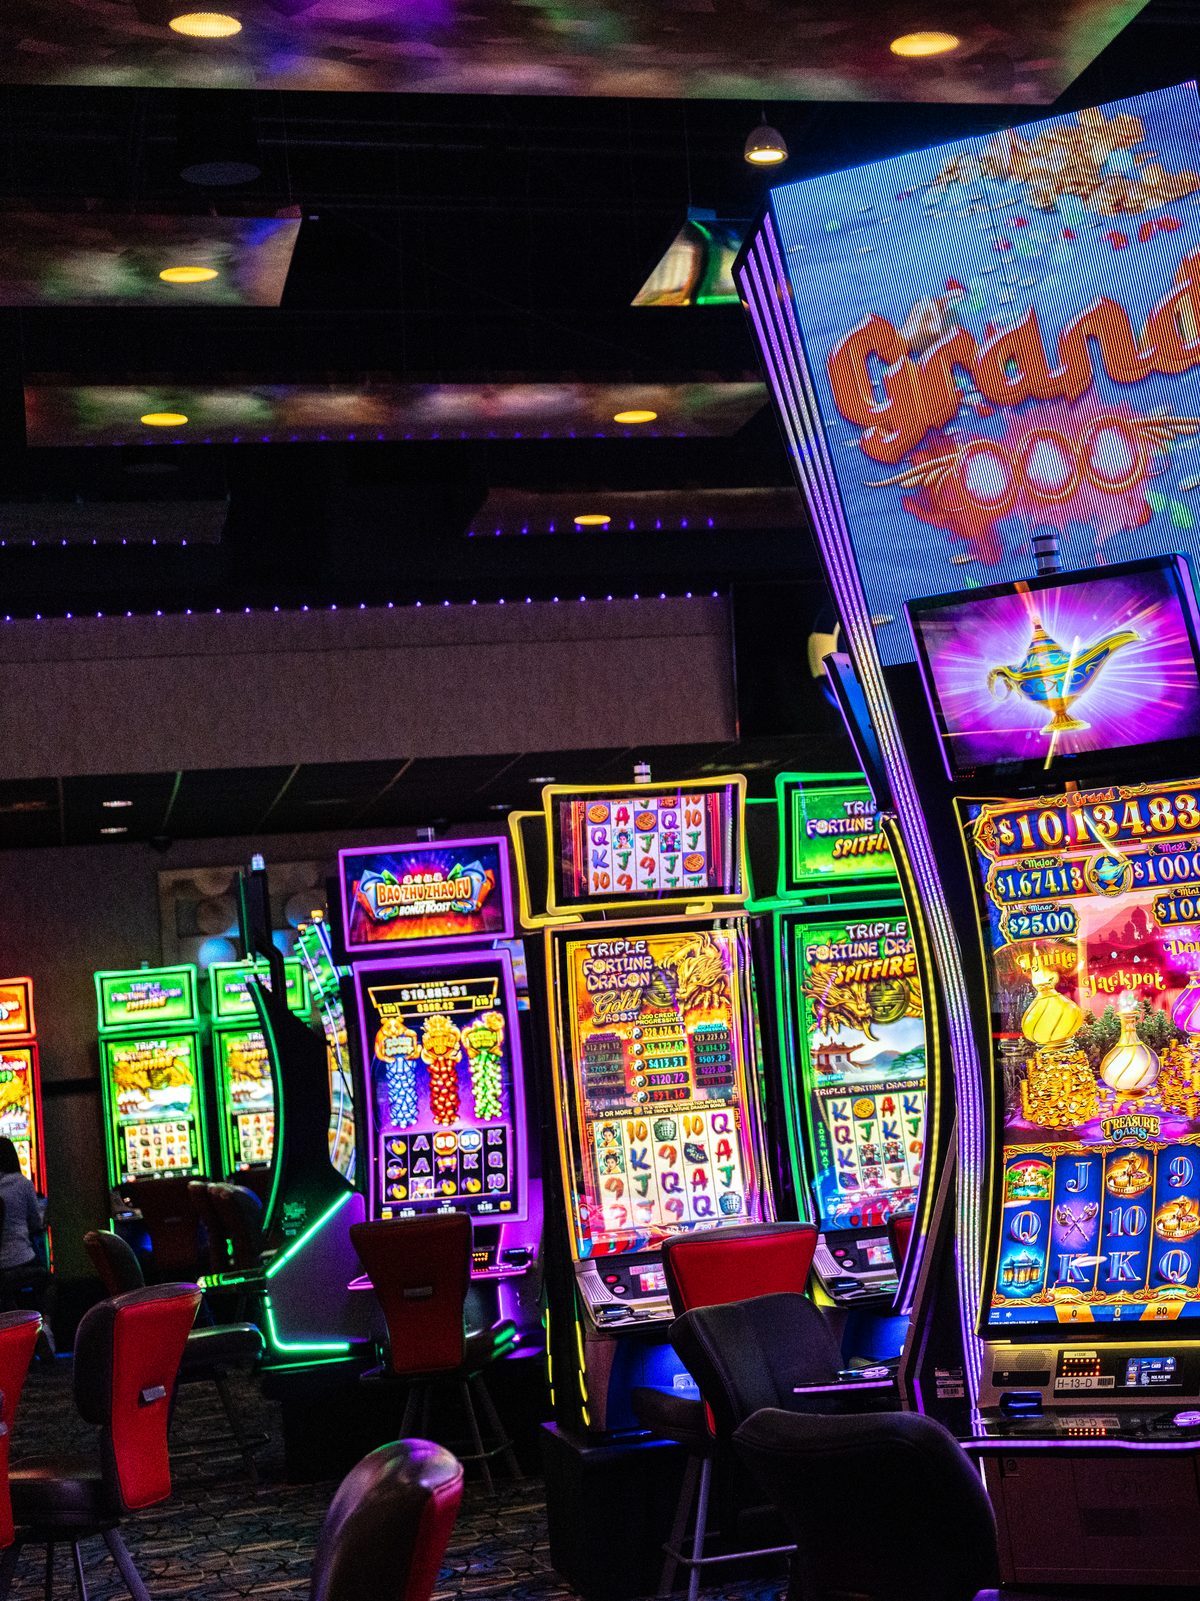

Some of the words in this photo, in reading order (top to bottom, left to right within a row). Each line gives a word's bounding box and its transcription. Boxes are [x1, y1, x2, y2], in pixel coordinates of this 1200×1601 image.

[1072, 787, 1115, 806] Grand
[615, 806, 630, 827] A
[661, 810, 680, 829] Q
[684, 809, 702, 828] 10
[806, 817, 874, 836] FORTUNE
[590, 827, 610, 846] Q
[639, 834, 655, 853] J
[686, 831, 702, 850] J
[591, 849, 610, 869] K
[616, 850, 632, 871] J
[640, 856, 656, 876] 9
[663, 854, 679, 874] J
[1025, 858, 1055, 869] Major
[376, 882, 400, 906] BAO
[401, 884, 425, 902] ZHU
[425, 880, 456, 899] ZHAO
[455, 876, 472, 898] FU
[592, 871, 611, 891] 10
[616, 873, 633, 892] 9
[996, 867, 1085, 898] $1,674.13
[1177, 886, 1200, 897] Mini
[425, 901, 451, 913] BOOST
[1027, 903, 1053, 912] Minor
[846, 922, 907, 939] TRIPLE
[1009, 911, 1074, 936] $25.00
[587, 940, 646, 957] TRIPLE
[806, 941, 879, 962] FORTUNE
[582, 956, 653, 975] FORTUNE
[834, 953, 915, 985] SPITFIRE
[1016, 948, 1077, 972] Ignite
[587, 971, 651, 991] DRAGON
[1081, 969, 1167, 998] Jackpot
[591, 987, 644, 1024] Gold
[605, 1012, 639, 1024] BOOST
[635, 1017, 684, 1026] PROGRESSIVES
[648, 1056, 684, 1068] $413.51
[651, 1072, 685, 1085] $120.72
[814, 1087, 847, 1097] TRIPLE
[848, 1083, 885, 1094] FORTUNE
[886, 1079, 919, 1090] DRAGON
[615, 1108, 633, 1116] MORE
[832, 1101, 851, 1122] K
[880, 1096, 896, 1117] A
[903, 1094, 922, 1114] K
[627, 1120, 648, 1144] 10
[682, 1115, 704, 1138] 10
[711, 1113, 733, 1135] Q
[834, 1125, 854, 1145] Q
[858, 1121, 875, 1142] J
[882, 1120, 900, 1140] K
[905, 1116, 922, 1138] J
[1102, 1115, 1159, 1136] TREASURE
[1112, 1127, 1148, 1140] OASIS
[413, 1135, 430, 1151] A
[487, 1129, 502, 1145] K
[413, 1157, 431, 1173] A
[463, 1153, 479, 1169] K
[488, 1151, 504, 1168] Q
[630, 1147, 651, 1171] K
[658, 1143, 677, 1168] 9
[715, 1138, 732, 1163] A
[837, 1148, 857, 1168] K
[487, 1173, 505, 1189] 10
[604, 1177, 624, 1200] 9
[633, 1173, 652, 1198] J
[661, 1172, 684, 1194] Q
[690, 1168, 709, 1193] A
[717, 1164, 735, 1188] J
[888, 1165, 905, 1186] J
[1066, 1161, 1092, 1193] J
[1169, 1156, 1194, 1187] 9
[665, 1197, 684, 1221] 9
[693, 1195, 715, 1217] Q
[1010, 1211, 1042, 1245] Q
[1106, 1205, 1147, 1237] 10
[1056, 1253, 1091, 1284] K
[1106, 1251, 1141, 1282] K
[1158, 1249, 1192, 1285] Q
[1071, 1309, 1078, 1318] 0
[1114, 1306, 1121, 1318] 0
[1156, 1306, 1168, 1315] 80
[1057, 1379, 1093, 1388] H-13-D
